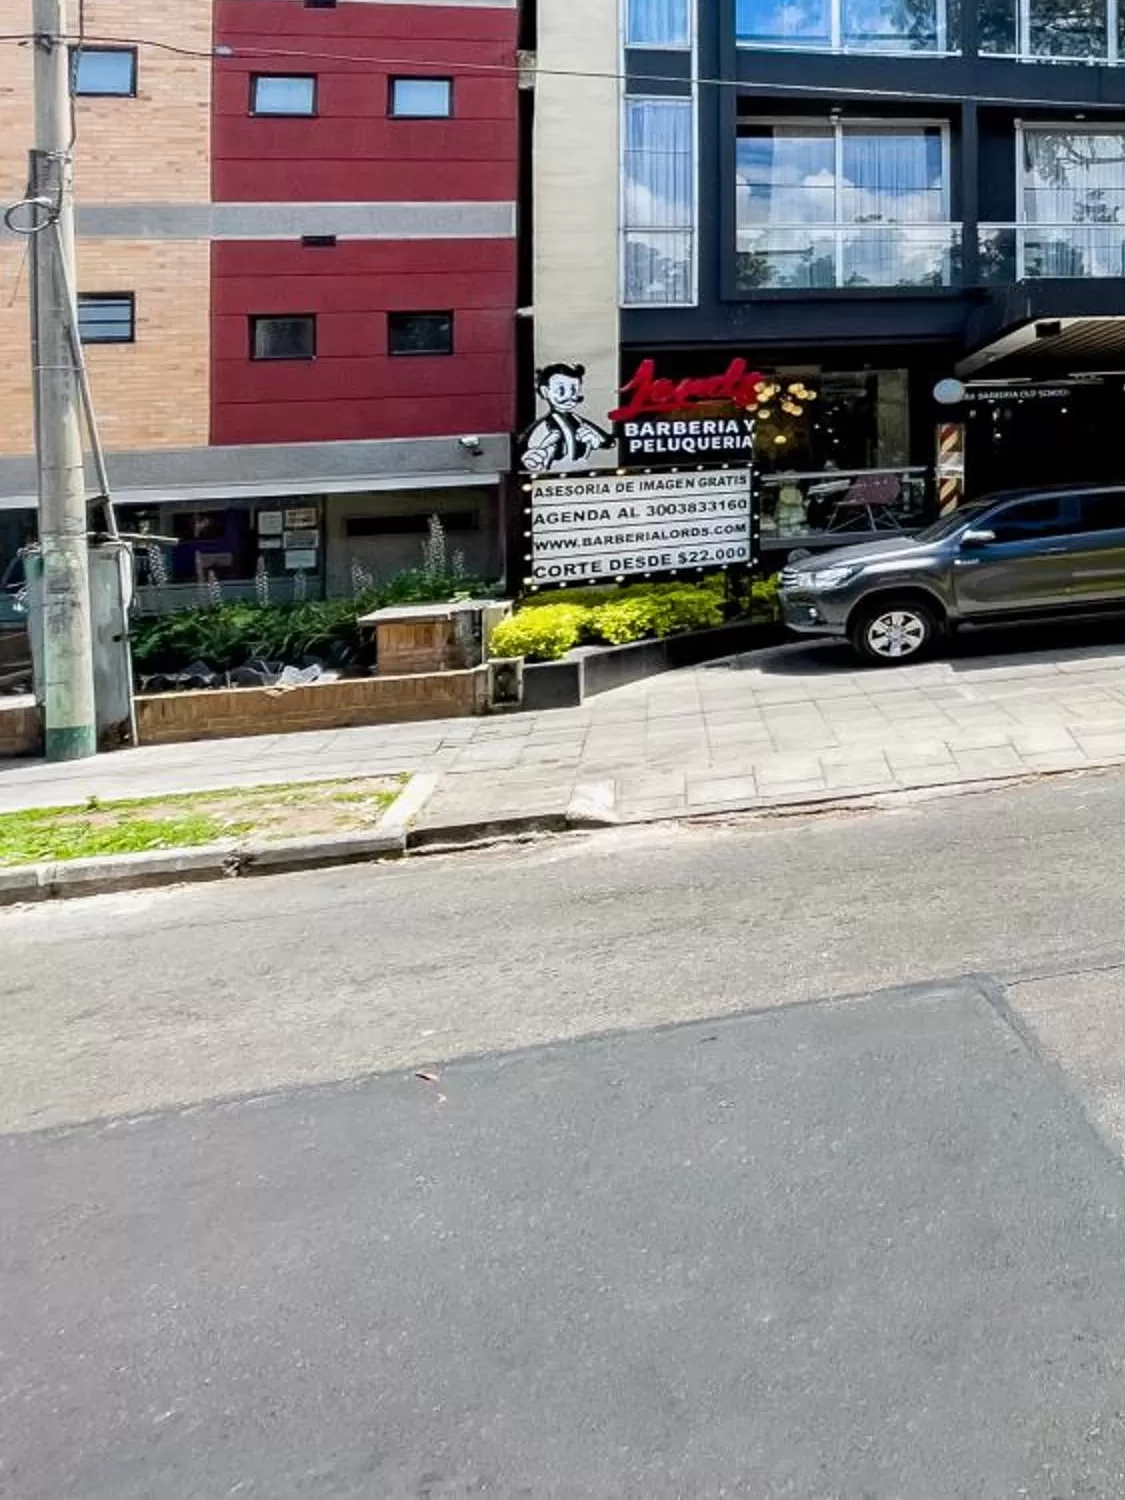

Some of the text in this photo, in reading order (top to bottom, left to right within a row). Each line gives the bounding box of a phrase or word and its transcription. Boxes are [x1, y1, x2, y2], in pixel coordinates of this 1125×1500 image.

[624, 419, 755, 437] BARBERIA Y
[629, 436, 753, 453] PELUQUERIA
[534, 475, 747, 498] ASESORIA DE IMAGEN GRATIS
[533, 498, 747, 525] AGENDA AL 3003833160
[534, 547, 747, 579] CORTE DESDE $22.000
